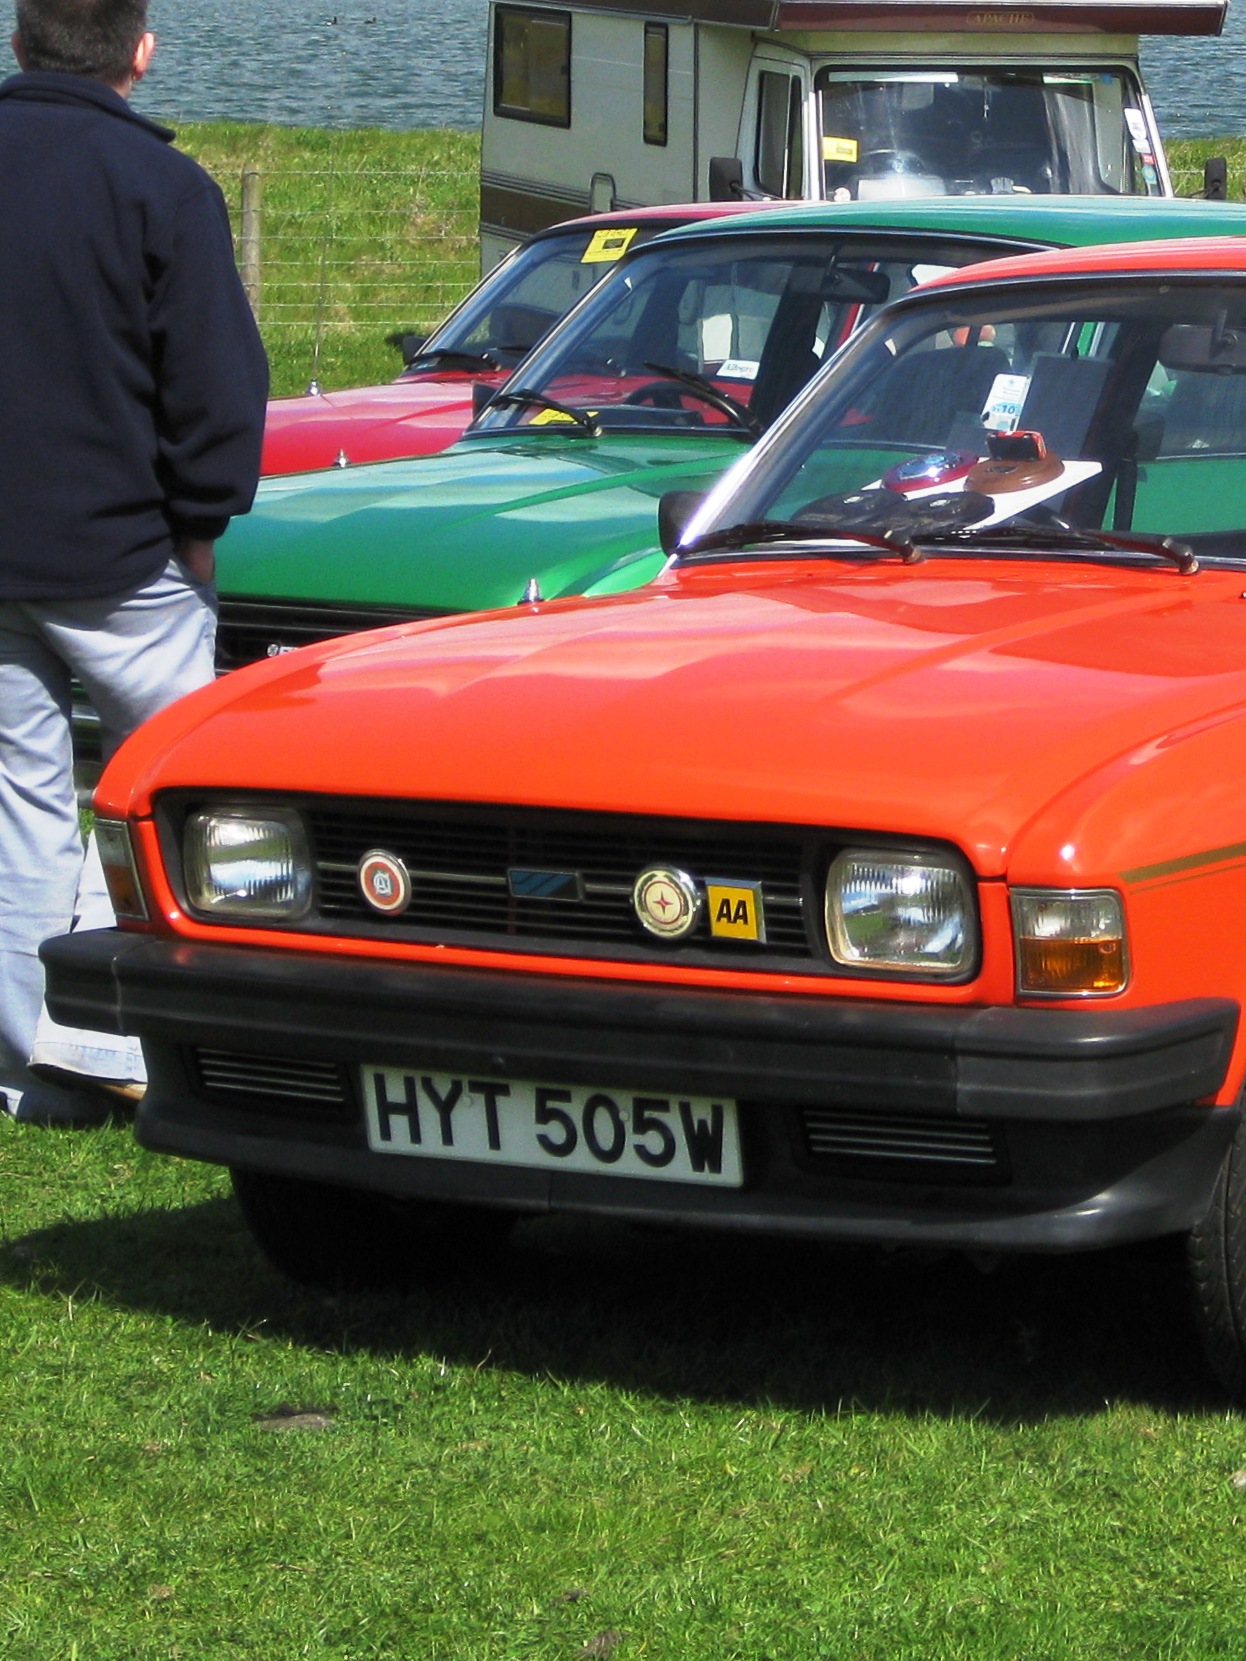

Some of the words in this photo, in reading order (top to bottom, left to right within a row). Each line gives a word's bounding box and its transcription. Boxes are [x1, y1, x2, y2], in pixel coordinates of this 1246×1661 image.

[715, 897, 749, 926] AA
[373, 1073, 511, 1151] HYT
[534, 1086, 724, 1175] 505W
